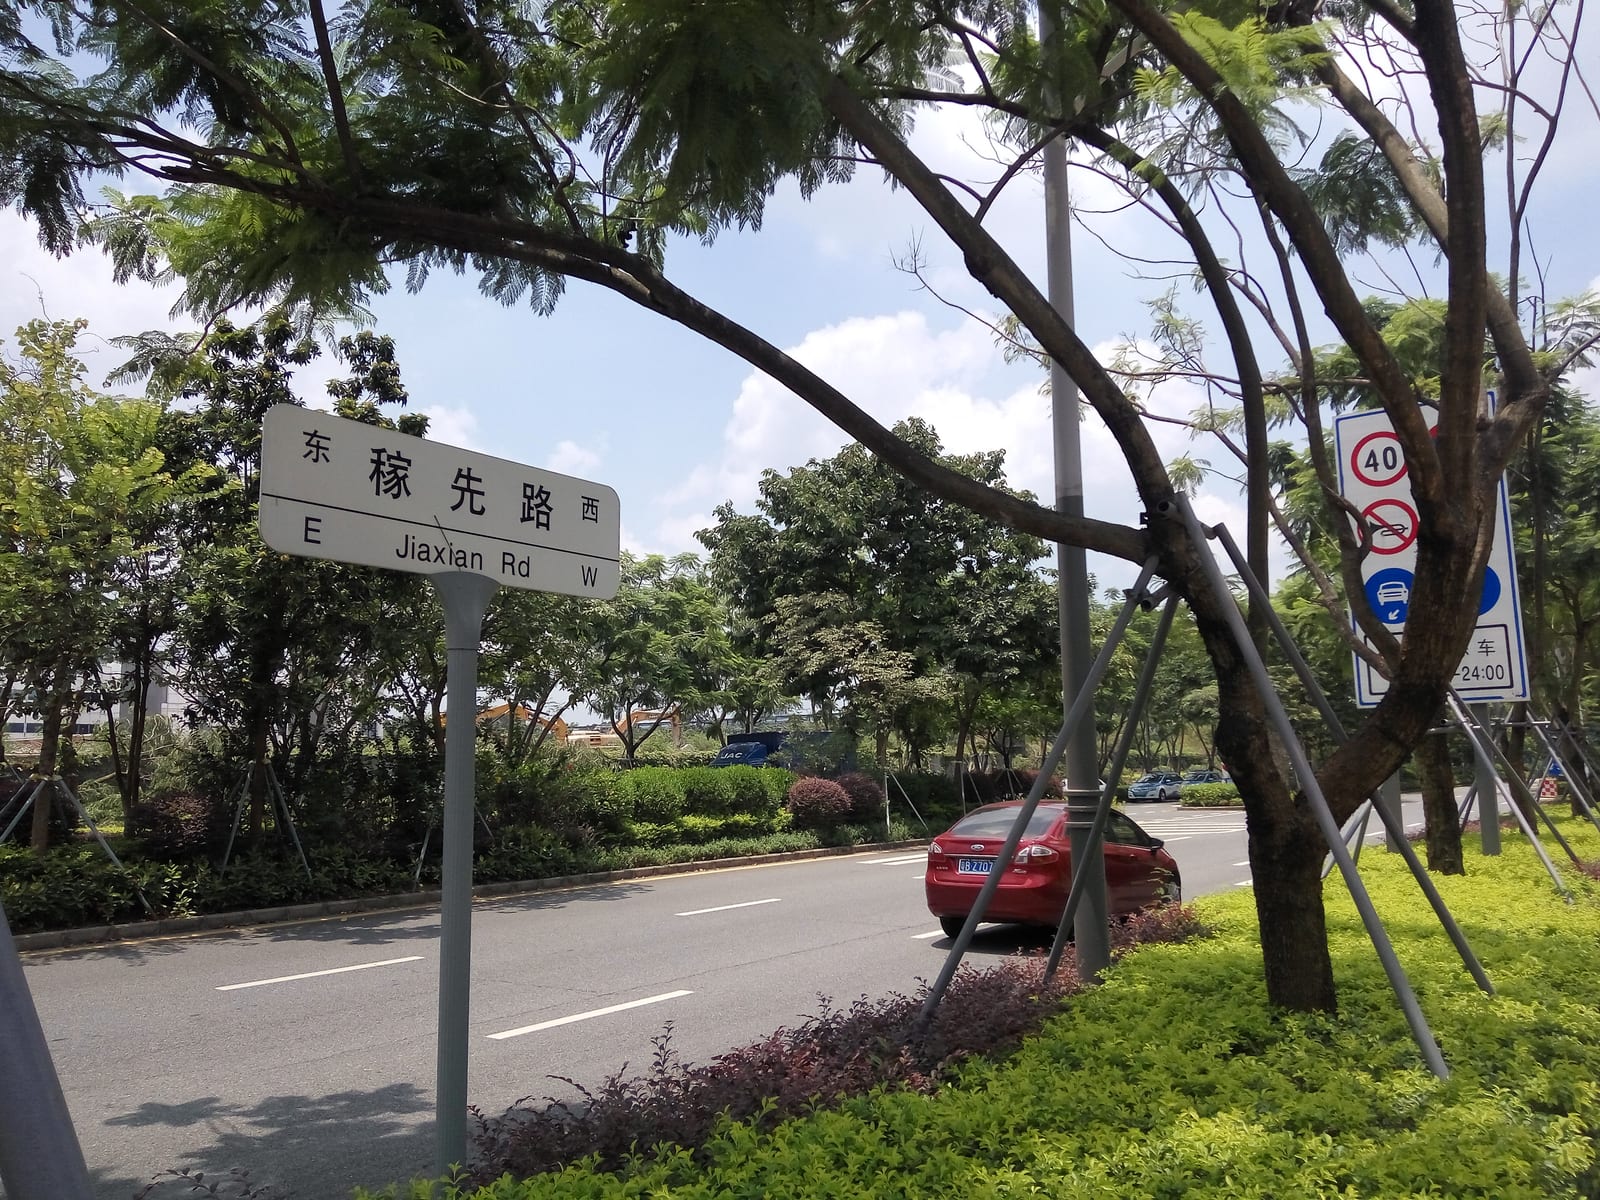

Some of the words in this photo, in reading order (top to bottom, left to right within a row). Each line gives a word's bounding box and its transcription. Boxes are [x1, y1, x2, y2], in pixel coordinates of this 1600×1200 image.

[302, 429, 331, 463] 东
[369, 447, 554, 531] 稼先路
[581, 495, 600, 524] 西
[1364, 446, 1398, 472] 40
[303, 516, 322, 545] E
[395, 534, 484, 571] Jiaxian
[501, 551, 531, 578] Rd
[581, 564, 598, 588] W
[1454, 664, 1504, 681] -24:00
